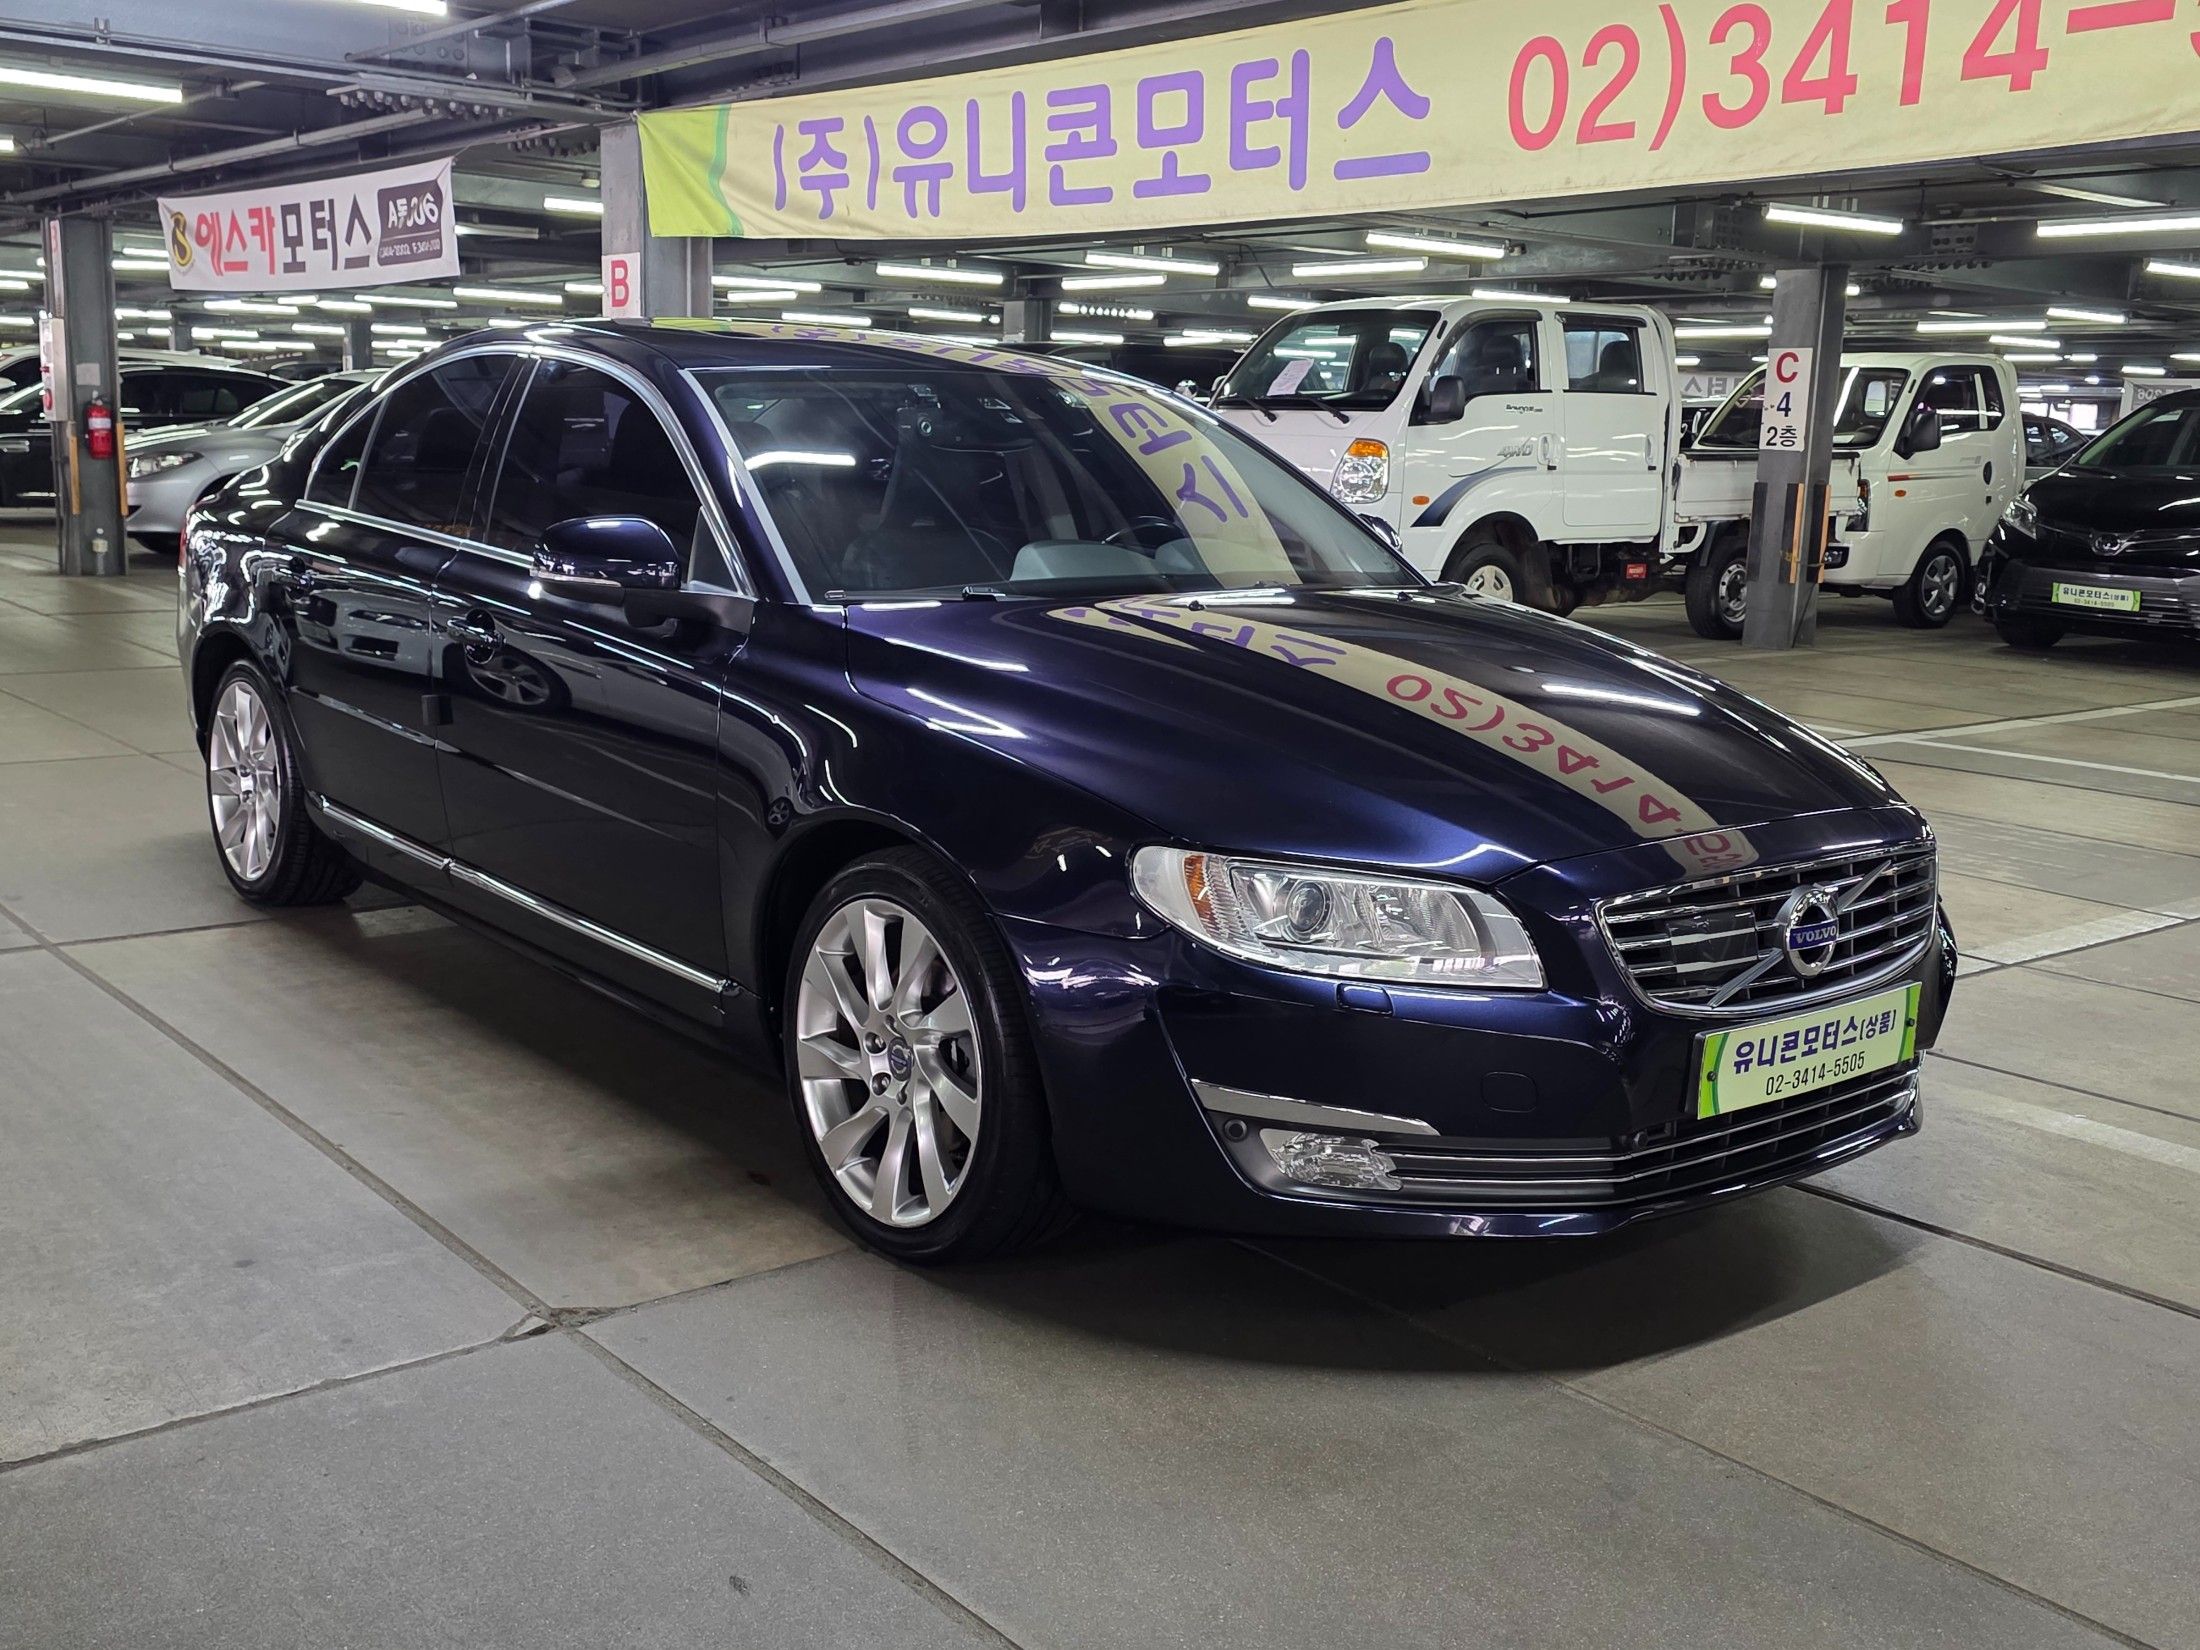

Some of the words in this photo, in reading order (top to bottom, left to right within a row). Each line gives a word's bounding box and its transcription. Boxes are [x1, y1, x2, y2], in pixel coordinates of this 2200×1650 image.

[1508, 0, 2200, 152] 02)3414-
[773, 36, 1432, 219] (주)유니콘모터스
[611, 260, 629, 307] B
[1776, 352, 1799, 383] C
[1777, 392, 1791, 417] 4
[1766, 425, 1797, 447] 2층
[1794, 926, 1836, 943] VOLVO
[1765, 1050, 1865, 1096] 02-3414-5505
